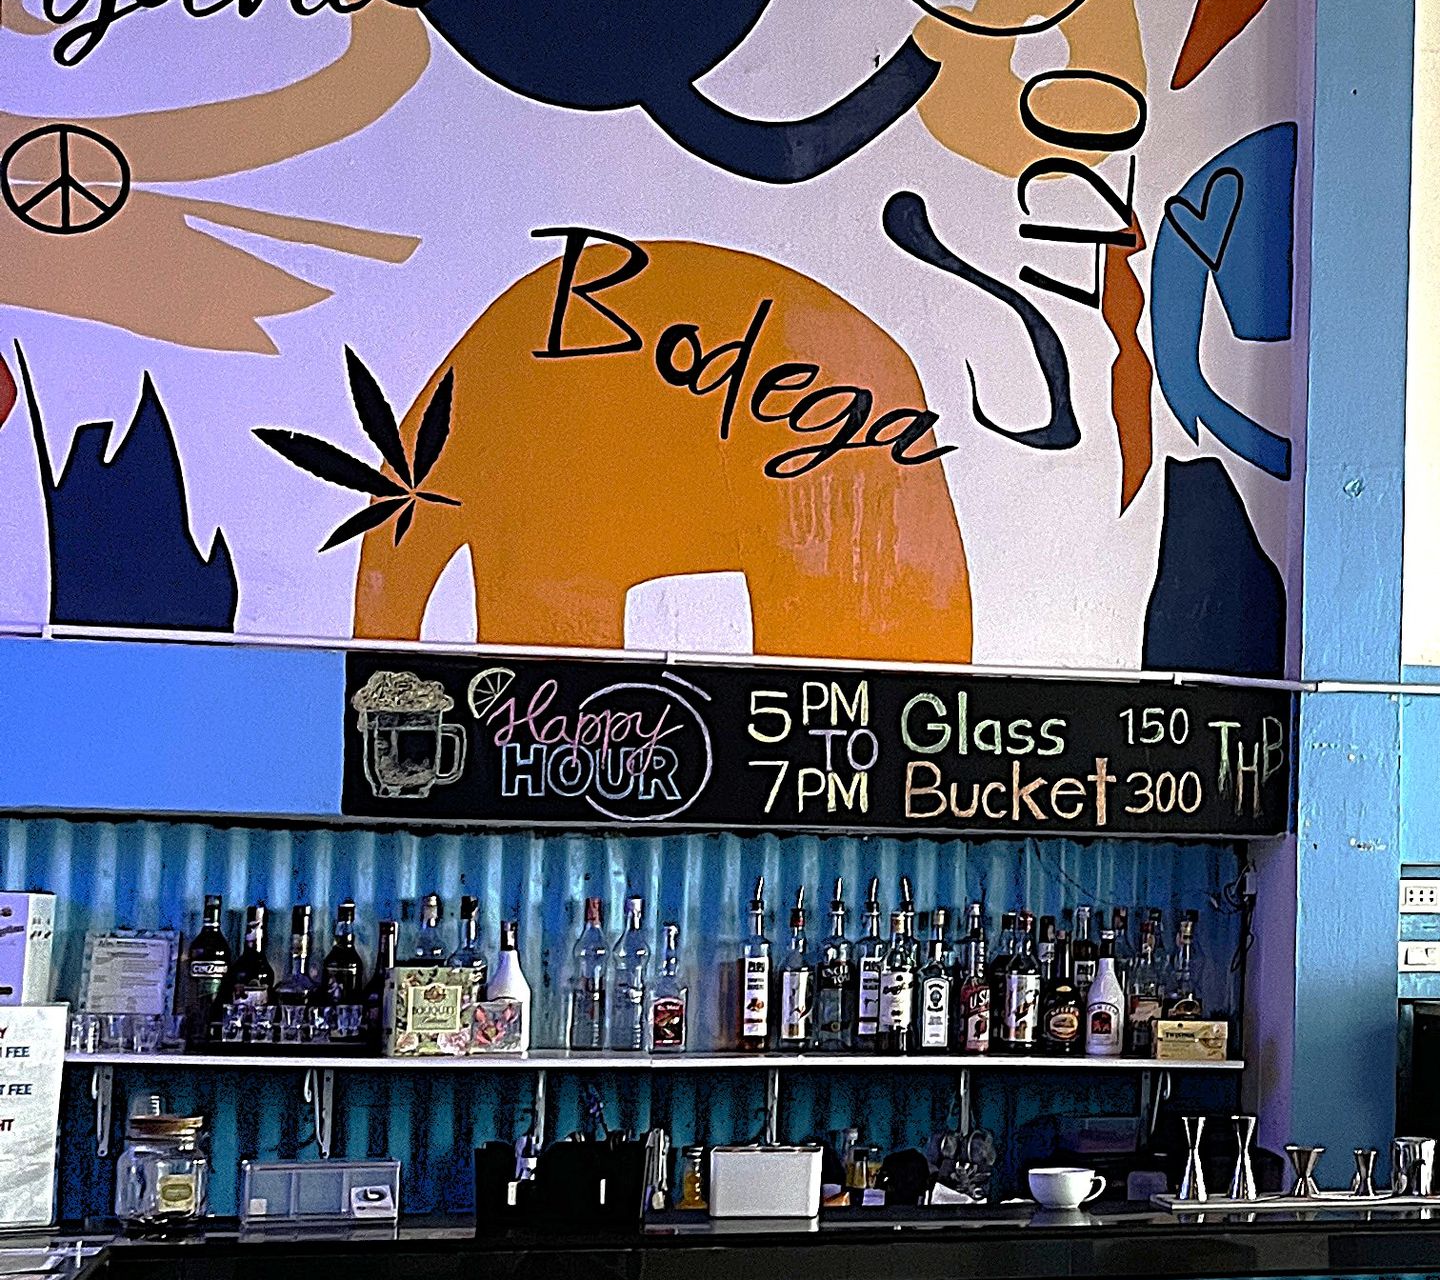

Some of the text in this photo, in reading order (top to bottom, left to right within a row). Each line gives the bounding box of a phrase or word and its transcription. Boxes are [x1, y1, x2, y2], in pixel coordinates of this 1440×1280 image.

[531, 227, 958, 478] Bodega
[486, 679, 684, 777] Happy
[748, 680, 868, 743] 5 PM
[901, 692, 1189, 755] Glass 150
[501, 743, 681, 800] HOUR
[809, 728, 878, 771] TO
[1208, 716, 1284, 818] THB
[749, 760, 868, 813] 7 PM
[905, 757, 1202, 826] Bucket 300
[6, 1046, 30, 1057] FEE
[8, 1084, 32, 1095] FEE
